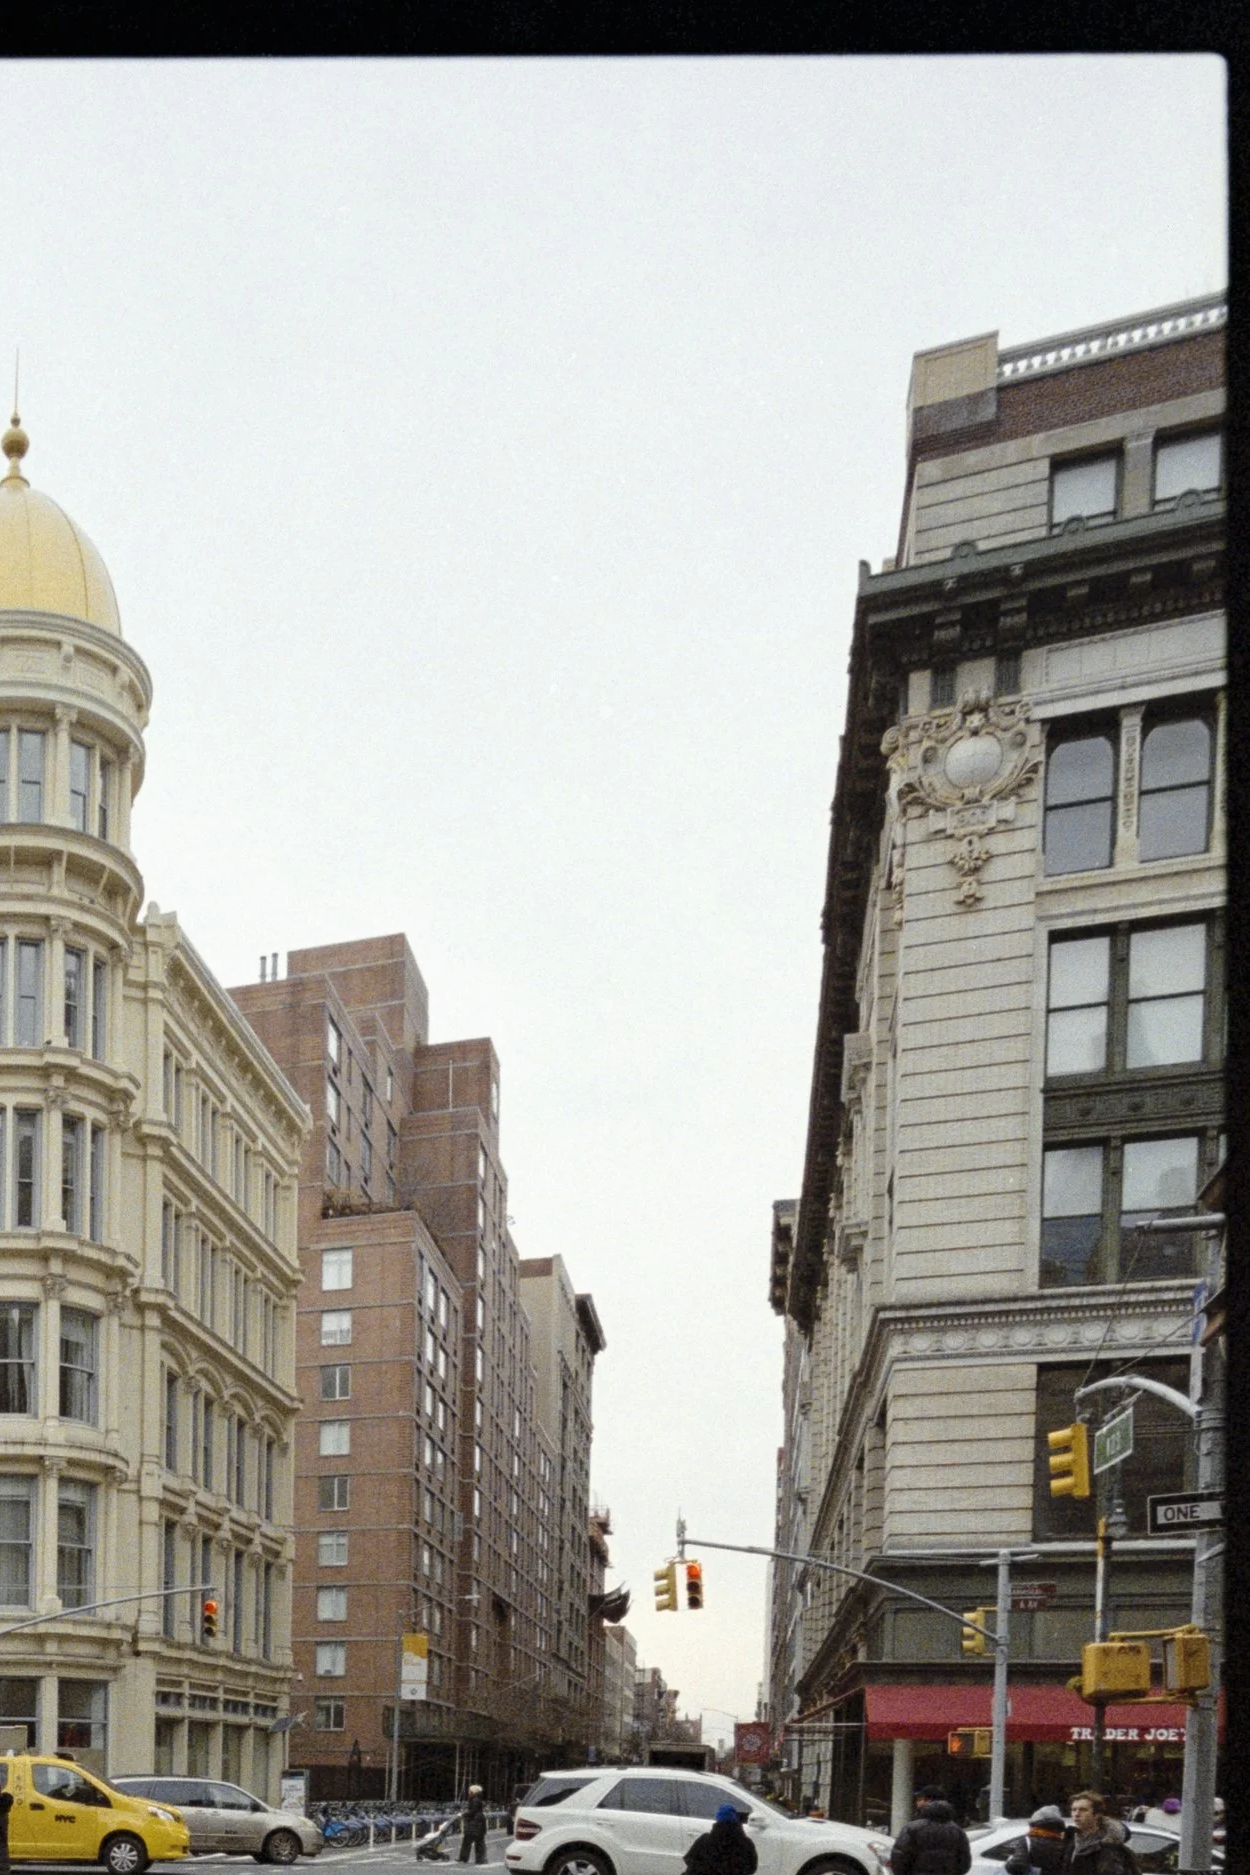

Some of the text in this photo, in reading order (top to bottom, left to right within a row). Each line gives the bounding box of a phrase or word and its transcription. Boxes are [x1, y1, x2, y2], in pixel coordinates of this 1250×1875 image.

[1163, 1504, 1200, 1522] ONE
[1070, 1726, 1140, 1741] TRDER
[54, 1814, 76, 1824] NYC
